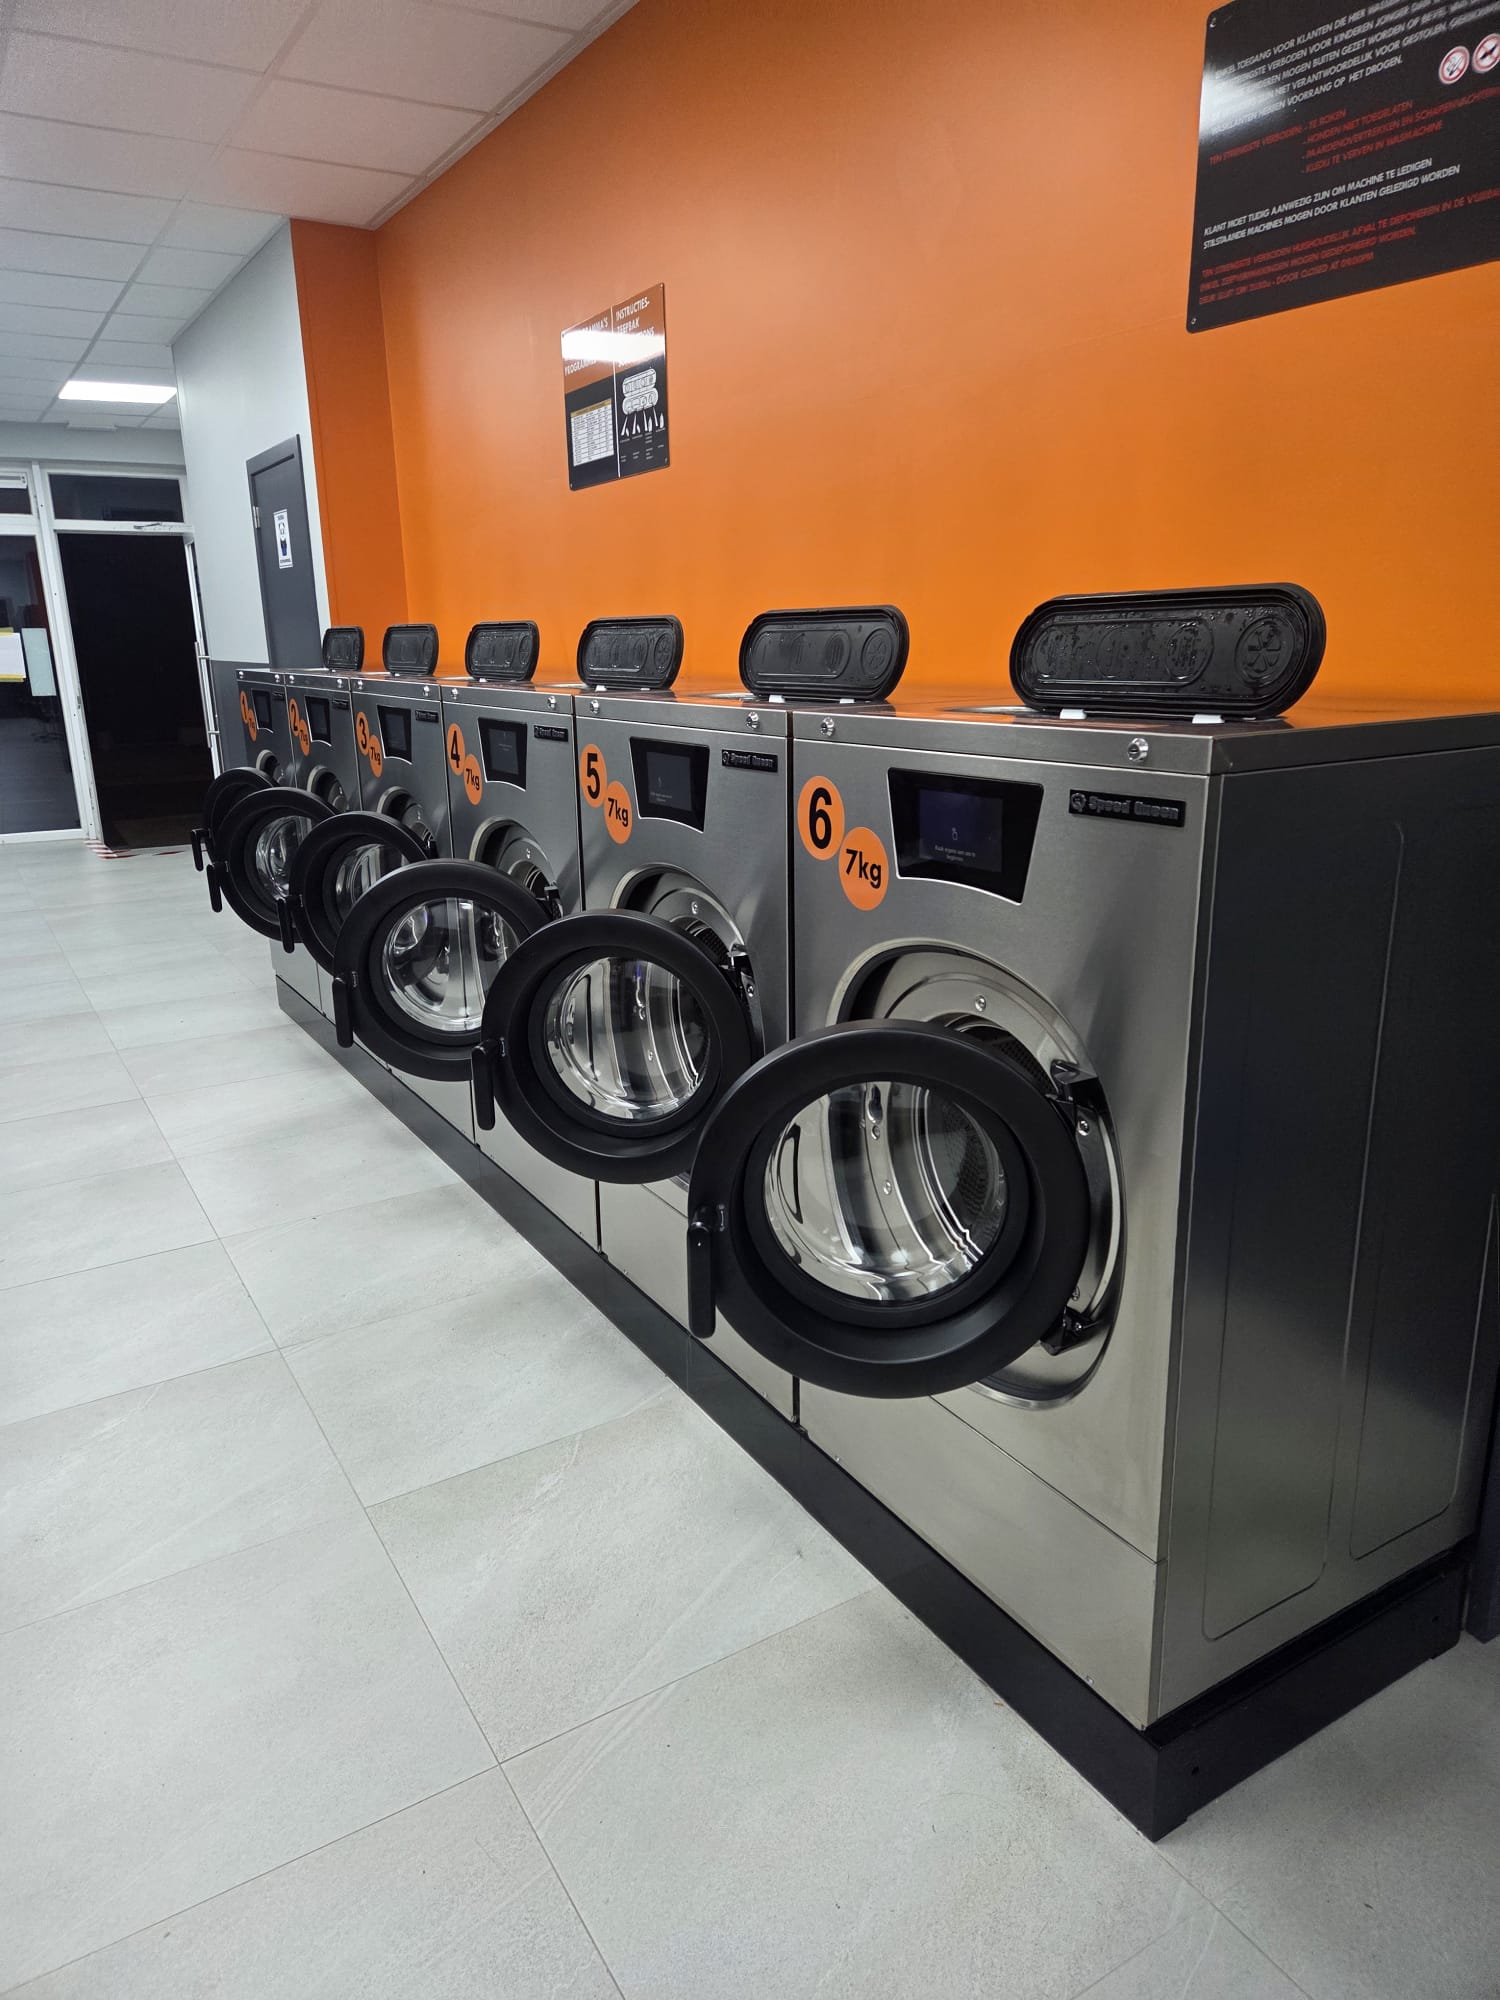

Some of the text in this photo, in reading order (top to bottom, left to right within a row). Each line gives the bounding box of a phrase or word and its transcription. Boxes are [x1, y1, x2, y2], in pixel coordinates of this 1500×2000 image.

[1237, 49, 1272, 70] TOEGANG
[1272, 39, 1295, 55] VOOR
[1297, 22, 1332, 45] KLANTEN
[1334, 16, 1347, 30] DIE
[1268, 48, 1308, 72] VERBODEN
[1309, 38, 1331, 54] VOOR
[1333, 20, 1374, 44] KINDEREN
[1281, 60, 1312, 80] MOGEN
[1312, 48, 1340, 68] BUITEN
[1342, 38, 1366, 56] GEZET
[1368, 22, 1406, 45] WORDEN
[1406, 17, 1420, 30] OP
[1375, 40, 1400, 58] VOOR
[1287, 81, 1332, 106] VOORRANG
[1334, 76, 1346, 88] OP
[1348, 70, 1363, 84] HET
[1365, 54, 1403, 78] DROGEN.
[1204, 222, 1226, 236] KLANT
[1227, 214, 1248, 230] MOET
[1270, 196, 1312, 216] AANWEZIG
[1313, 188, 1330, 203] ZIJN
[1332, 184, 1346, 197] OM
[1347, 172, 1384, 192] MACHINE
[1386, 169, 1396, 180] TE
[1397, 158, 1432, 177] LEDIGEN
[1247, 218, 1284, 236] MACHINES
[1284, 208, 1314, 226] MOGEN
[1314, 202, 1338, 216] DOOR
[1340, 190, 1378, 209] KLANTEN
[1379, 176, 1420, 197] GELEDIGD
[1421, 164, 1460, 184] WORDEN
[616, 297, 650, 321] INSTRUCTIES-
[291, 704, 298, 731] 2
[359, 718, 367, 750] 3
[451, 731, 460, 768] 4
[466, 769, 480, 791] 7kg
[587, 752, 600, 799] 5
[608, 797, 629, 827] 7kg
[809, 787, 832, 849] 6
[1089, 796, 1131, 814] Speed
[846, 848, 881, 889] 7kg
